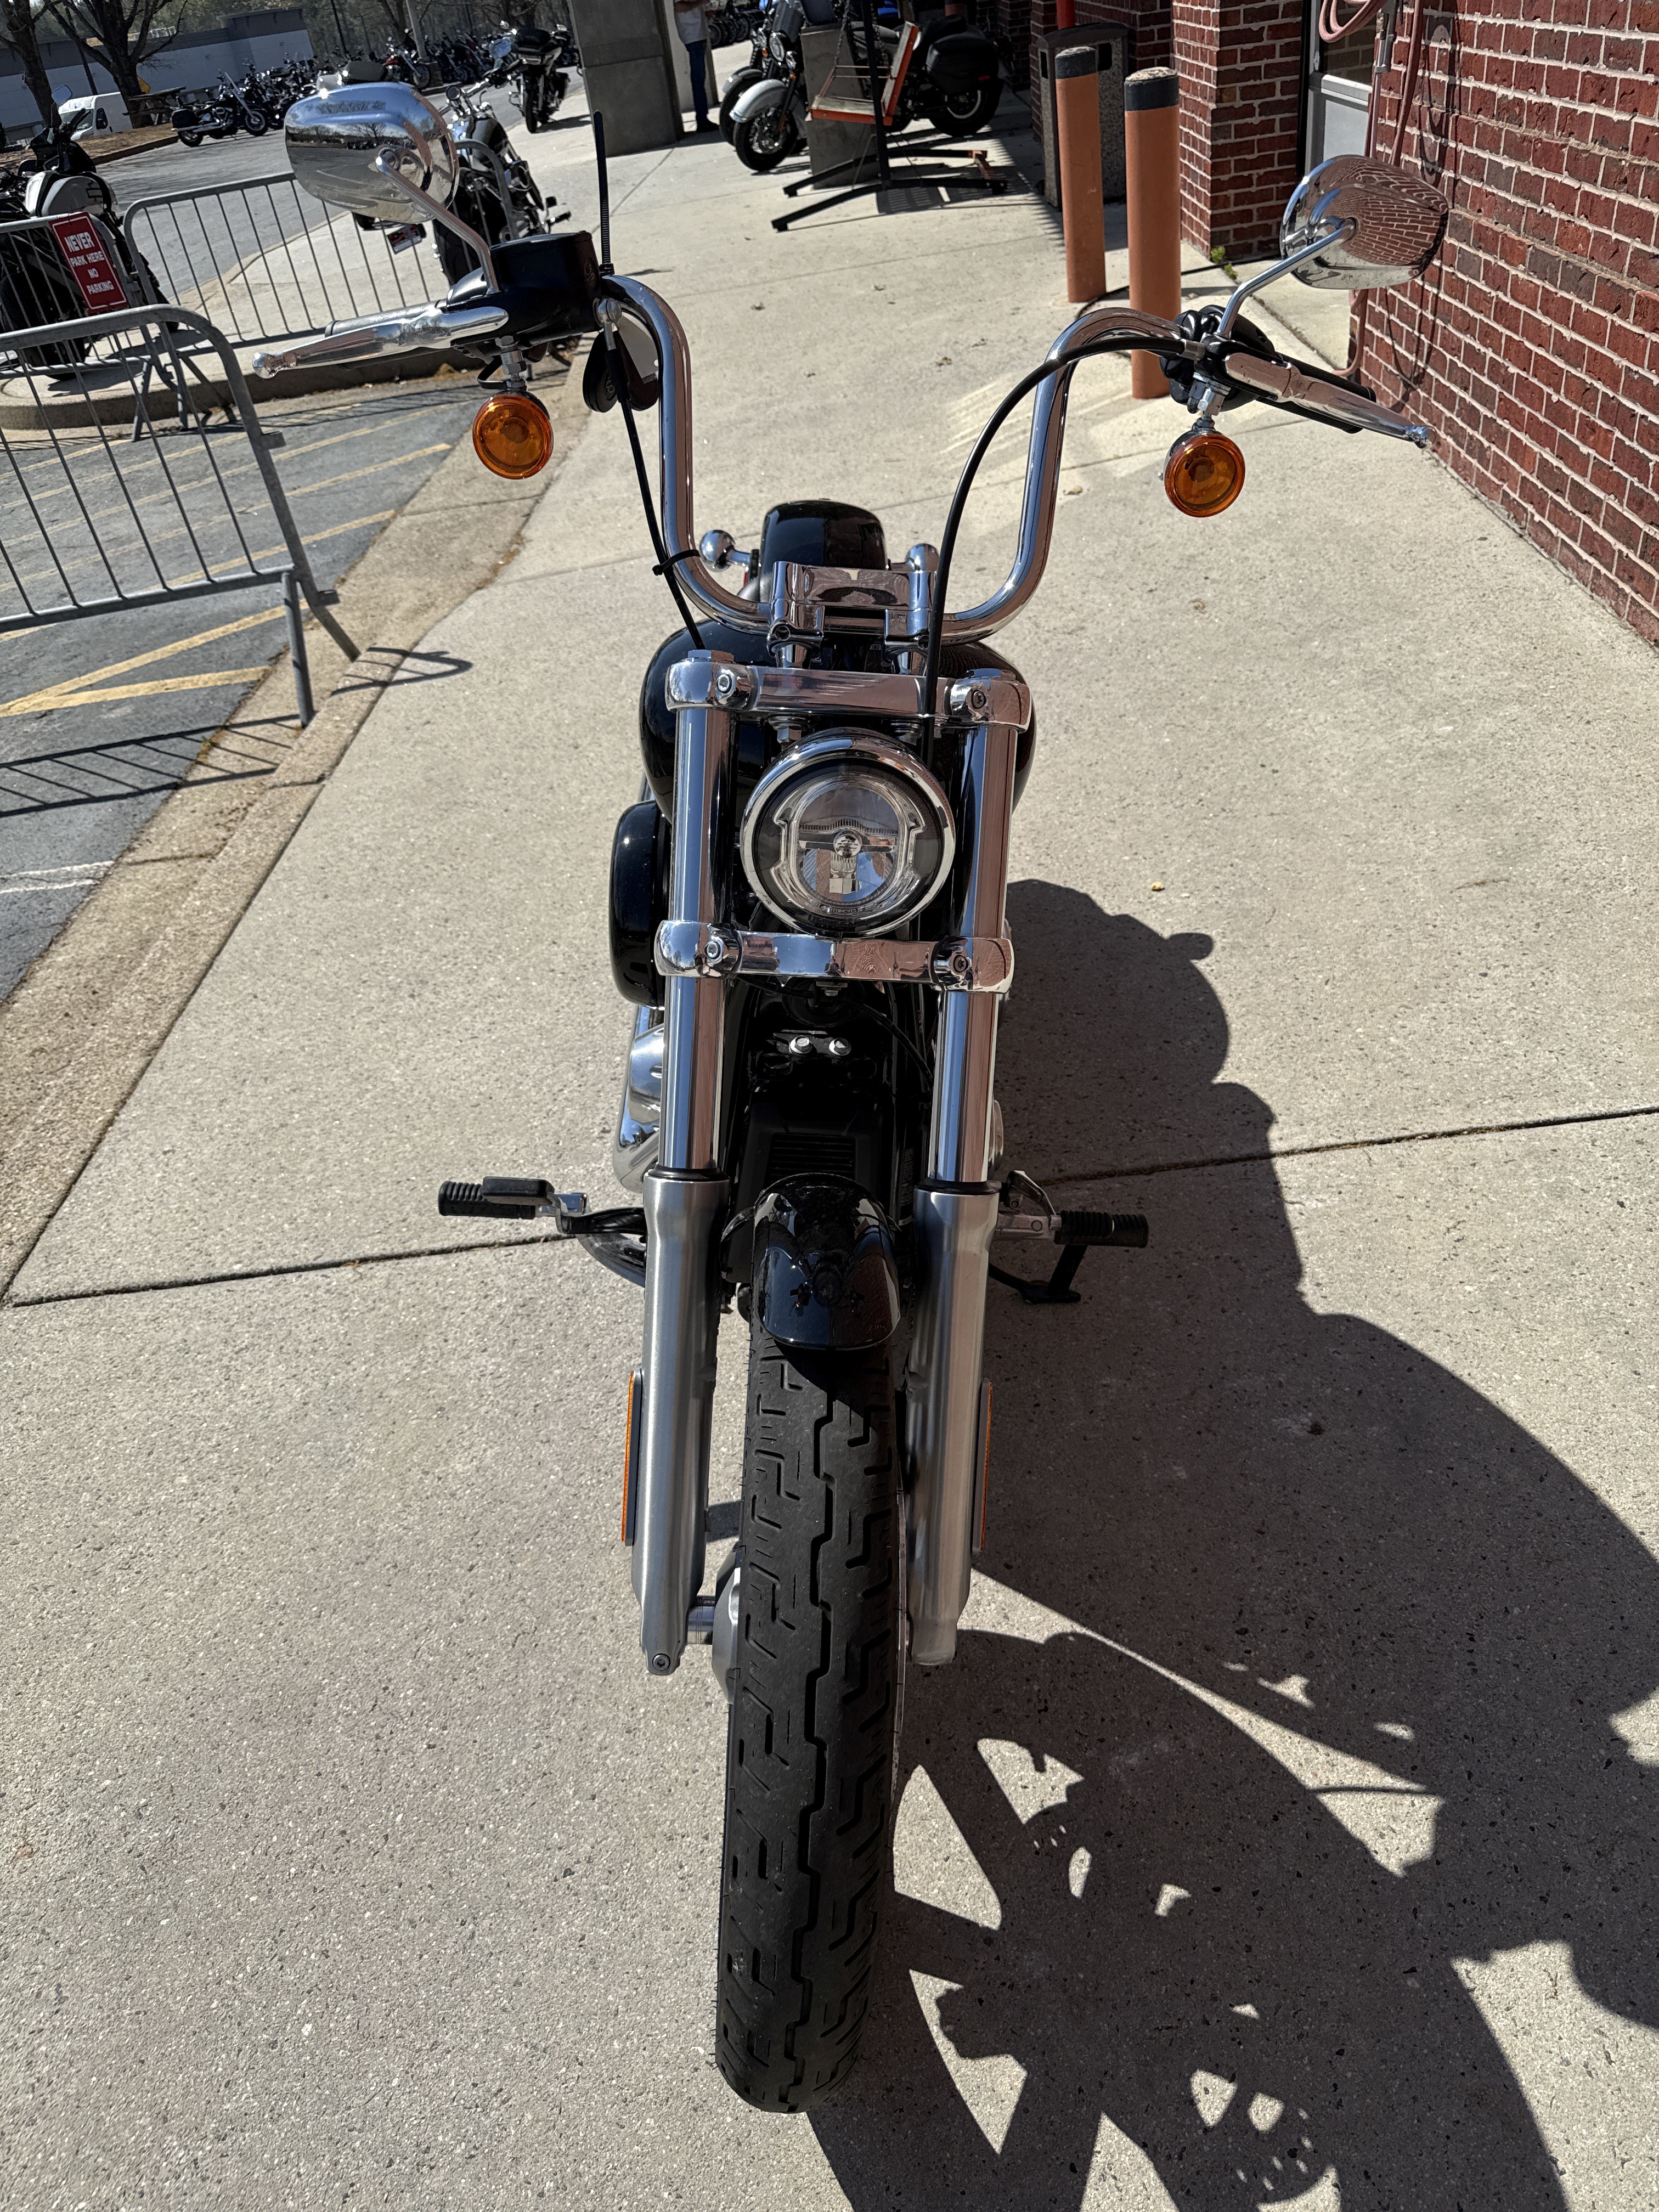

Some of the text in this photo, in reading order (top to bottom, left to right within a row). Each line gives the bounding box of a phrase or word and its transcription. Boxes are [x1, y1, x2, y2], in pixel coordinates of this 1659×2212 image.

[64, 232, 95, 252] NEVER
[69, 251, 105, 267] PARK HERE
[88, 268, 99, 279] NO
[86, 280, 114, 295] PARKING
